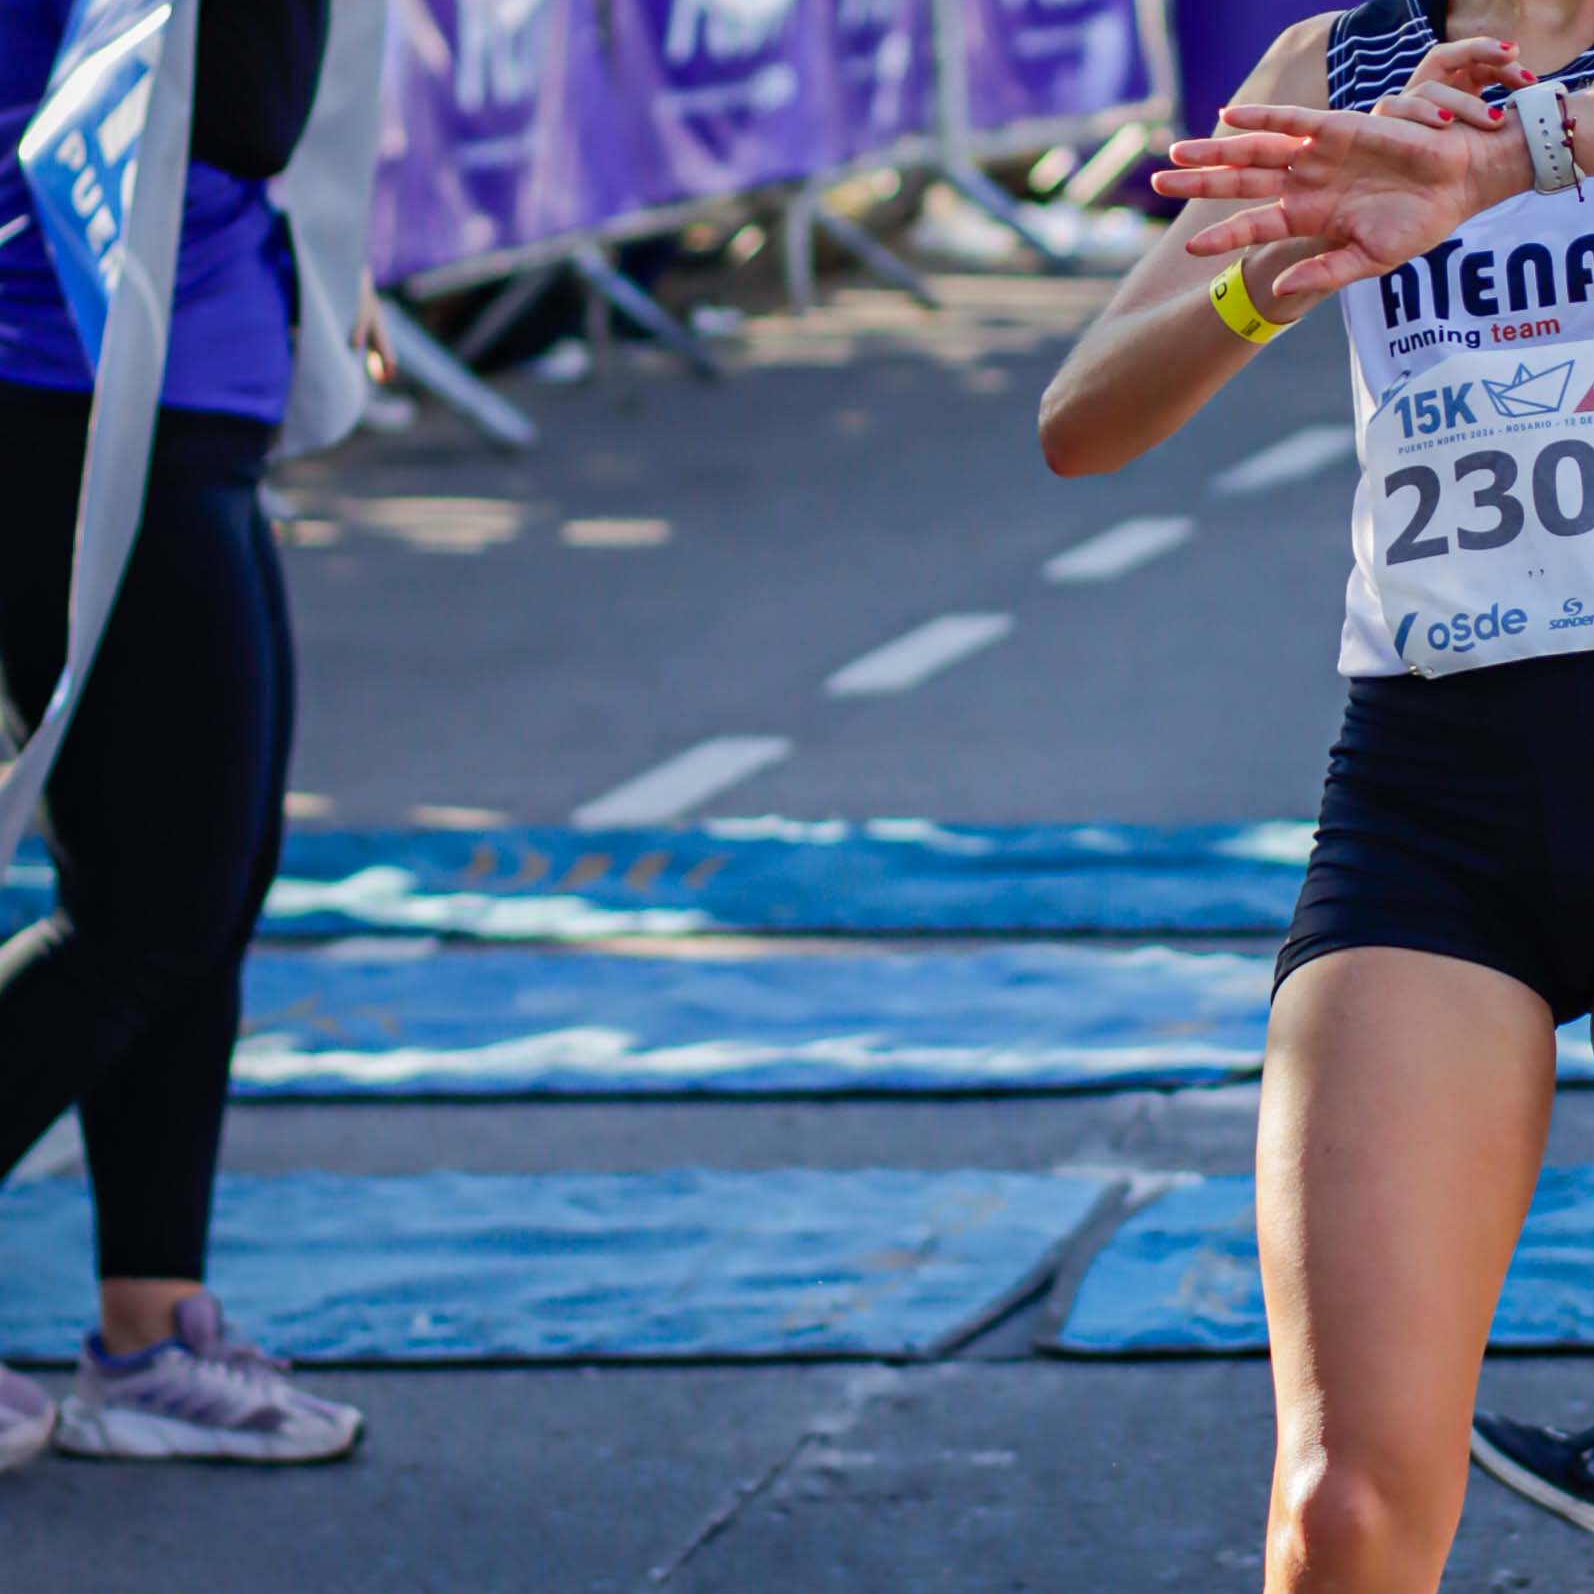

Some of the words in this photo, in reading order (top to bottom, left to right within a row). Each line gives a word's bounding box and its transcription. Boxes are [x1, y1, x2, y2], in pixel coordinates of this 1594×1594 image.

[1389, 325, 1480, 357] running
[1491, 318, 1560, 342] team
[1394, 381, 1478, 438] 15K
[1398, 439, 1434, 454] PUERTO
[1437, 432, 1467, 446] NORTE
[1471, 426, 1495, 439] 2026
[1506, 420, 1551, 433] ROSARIO
[1564, 415, 1576, 426] 12
[1580, 415, 1593, 425] DE
[1427, 603, 1528, 651] osde
